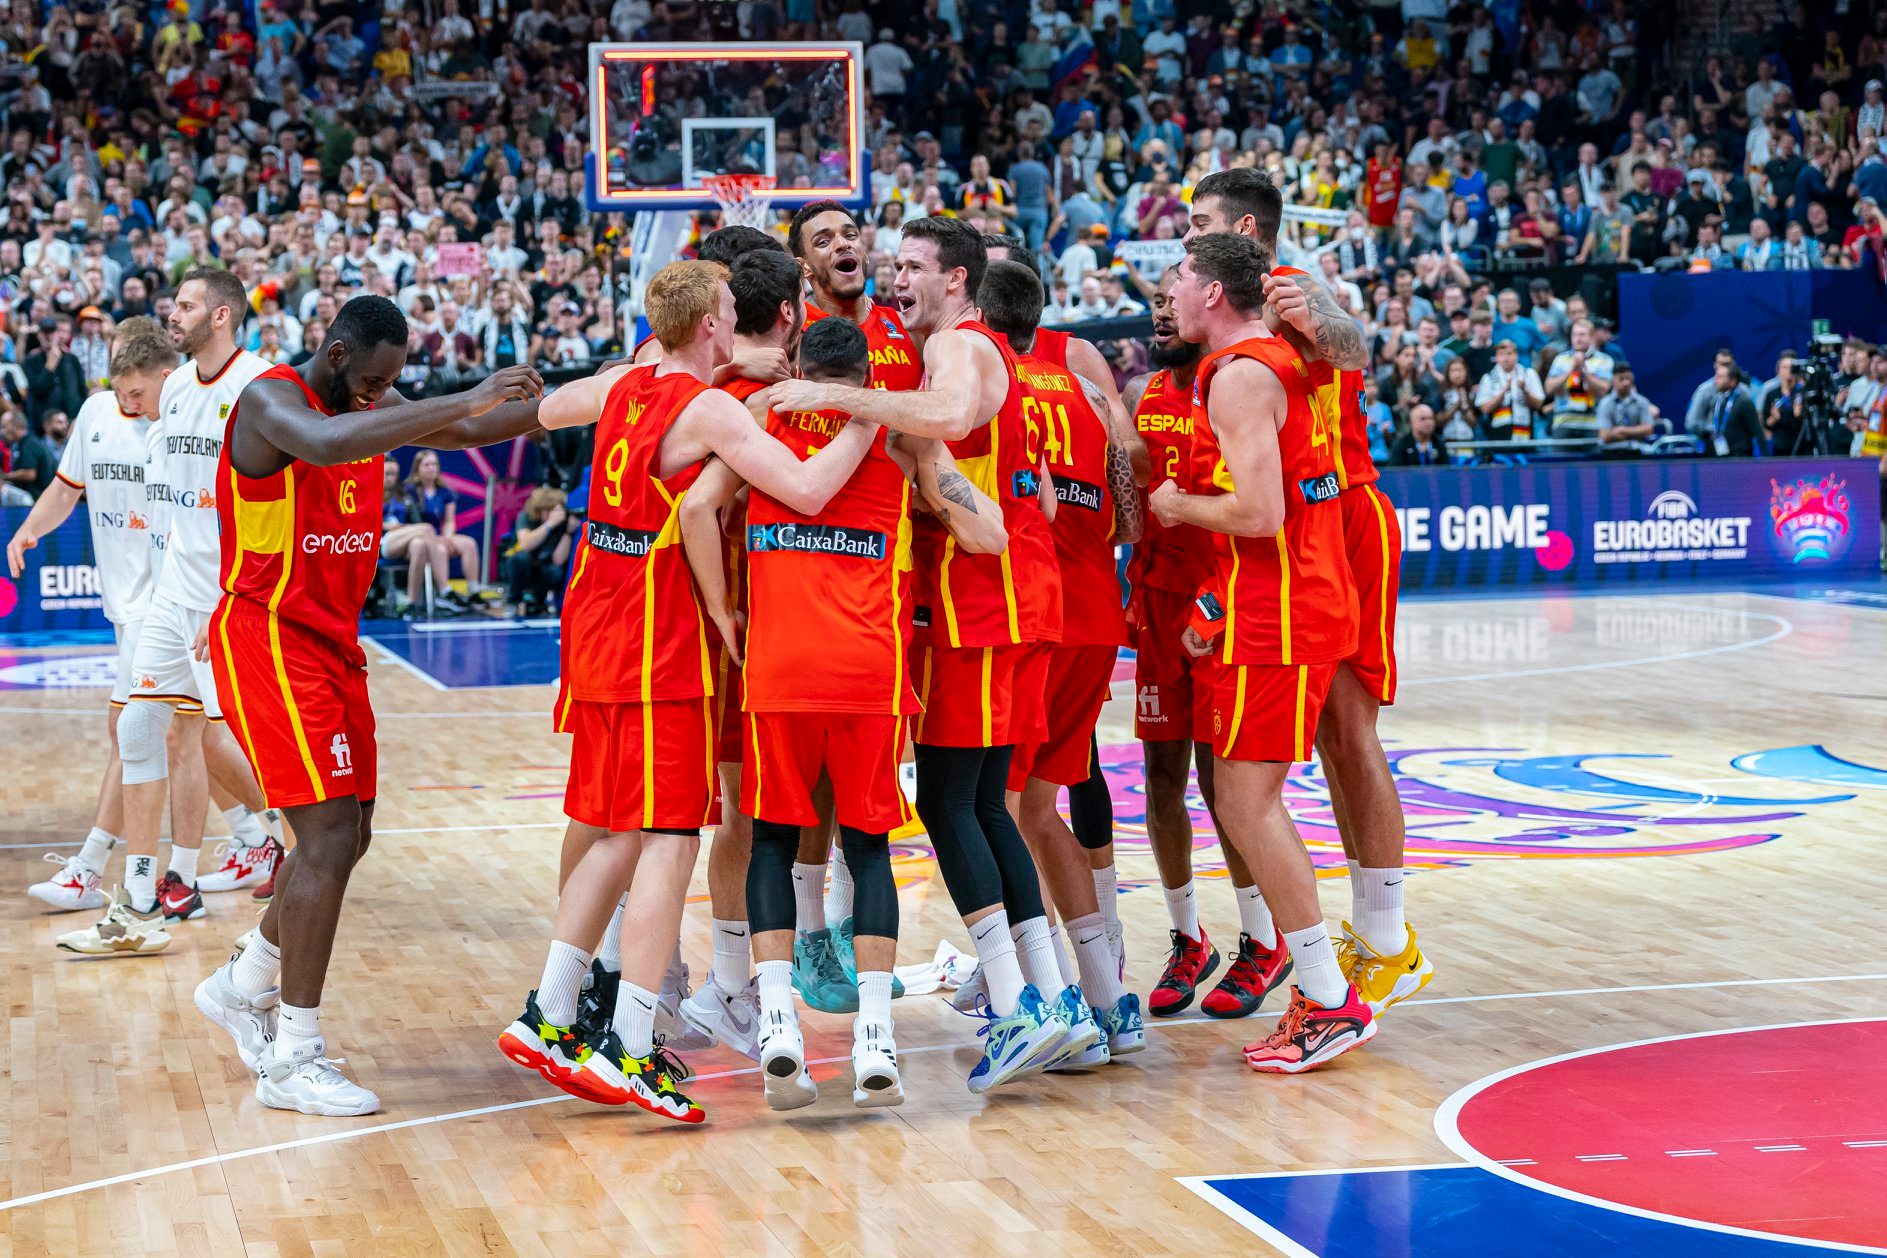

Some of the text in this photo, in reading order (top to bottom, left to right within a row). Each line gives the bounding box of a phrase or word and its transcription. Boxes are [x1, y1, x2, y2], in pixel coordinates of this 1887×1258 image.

[603, 438, 629, 507] 9
[1165, 446, 1180, 477] 2
[339, 480, 357, 514] 16
[95, 511, 125, 528] ING
[1439, 504, 1550, 551] GAME
[1594, 516, 1752, 551] EUROBASKET
[777, 526, 879, 556] CaixaBank
